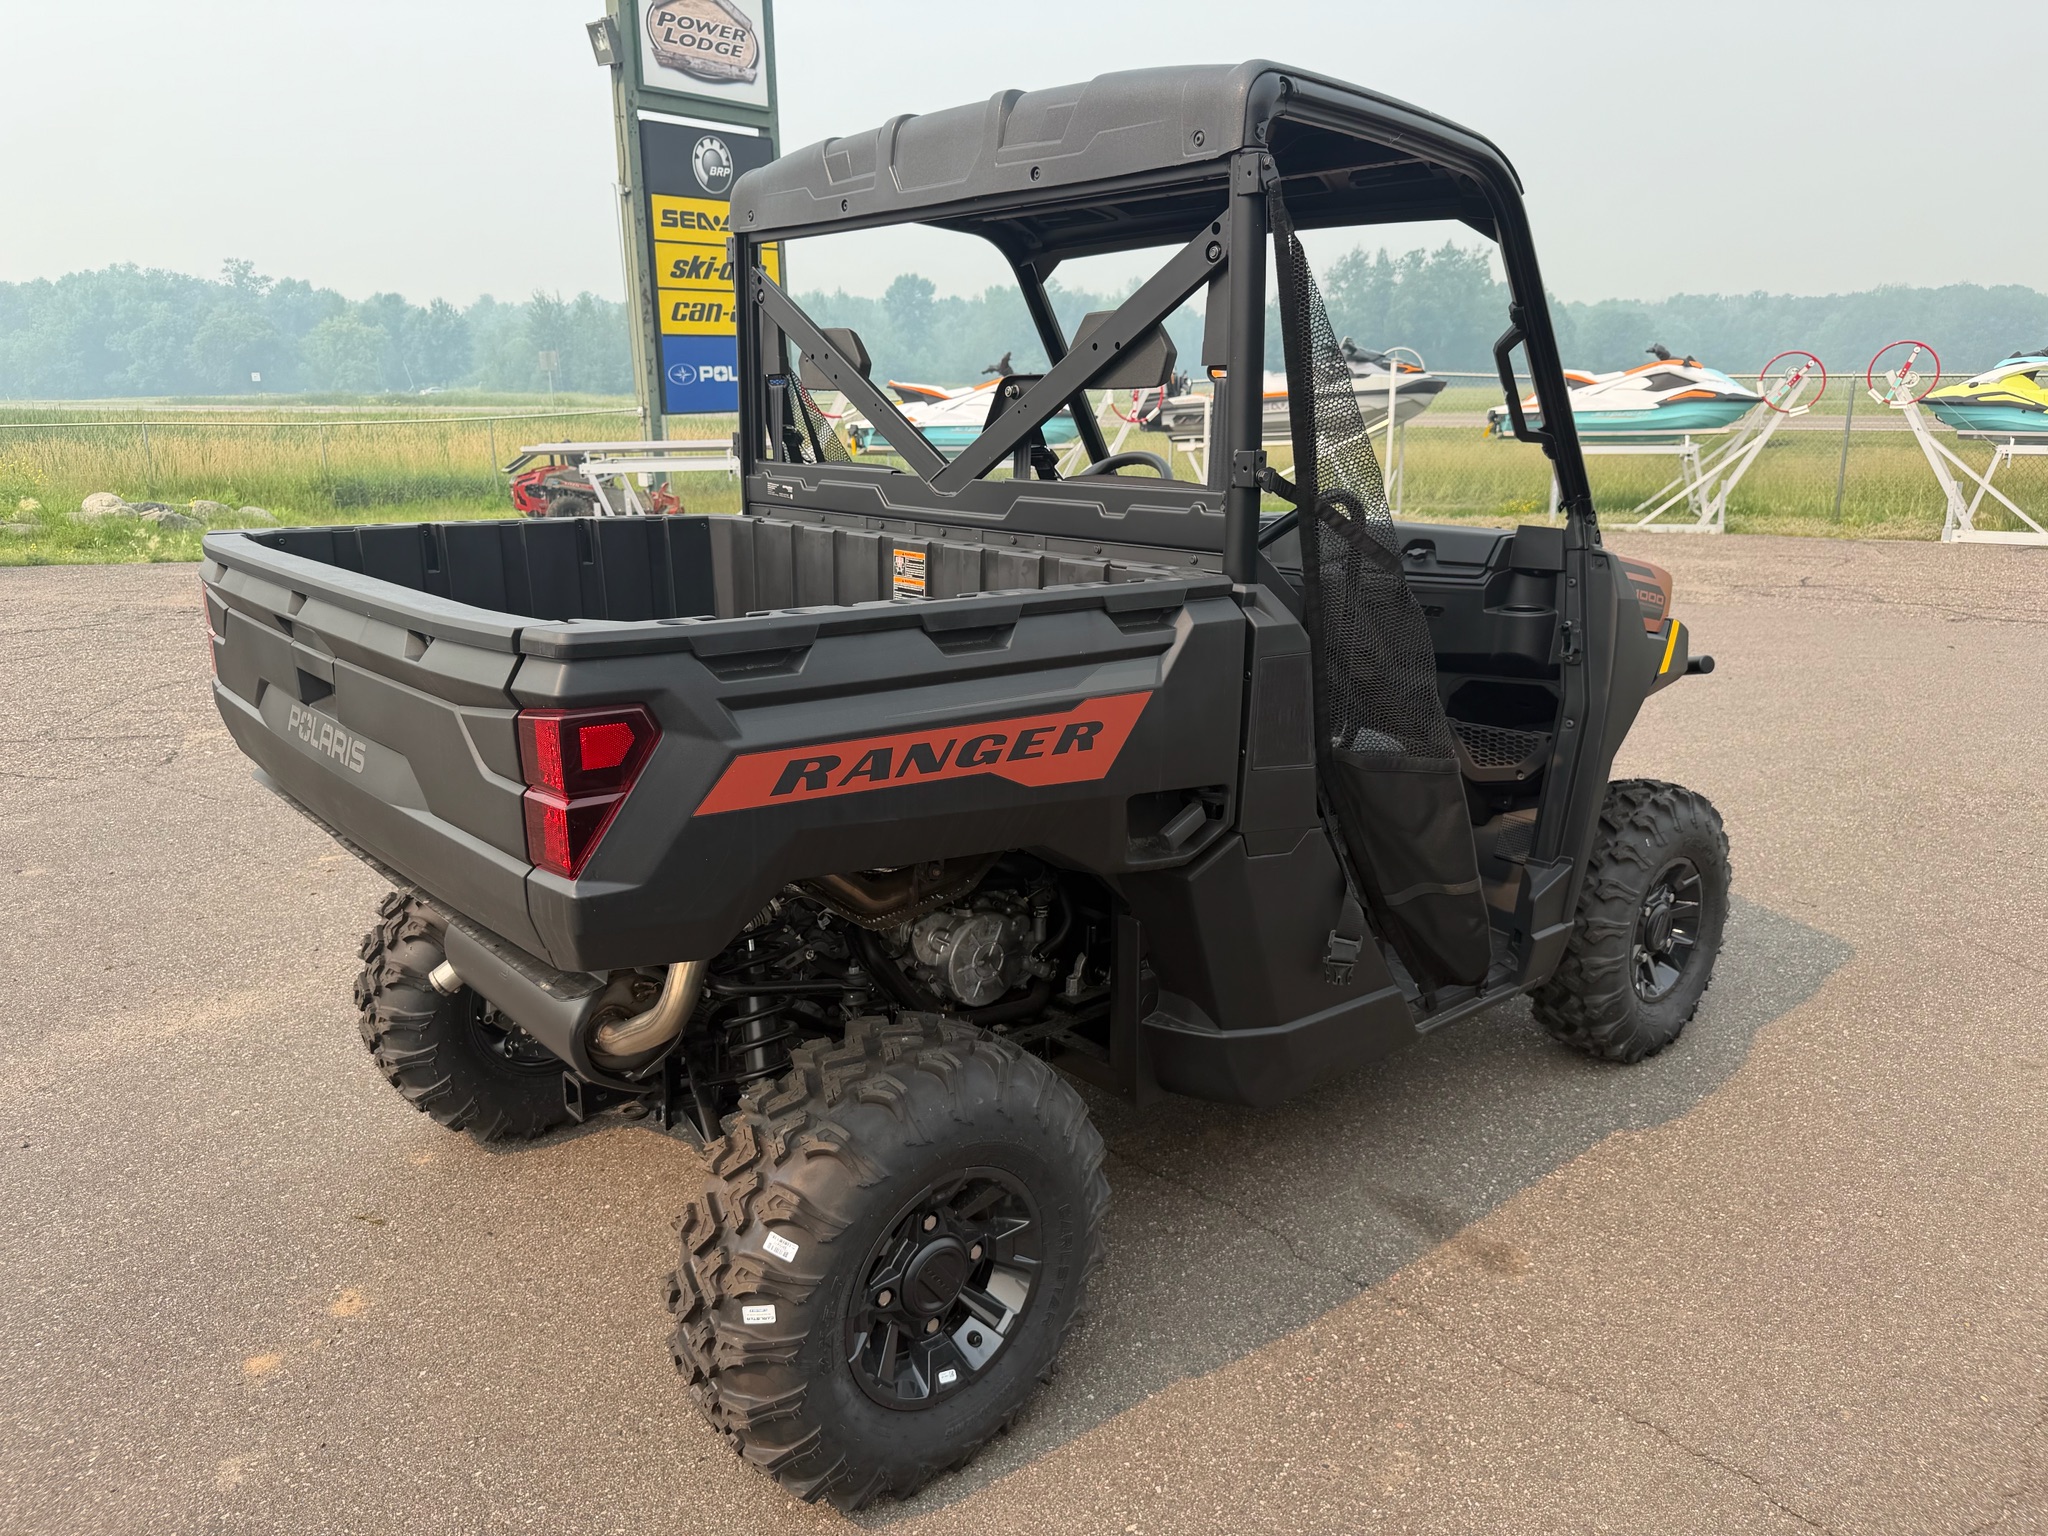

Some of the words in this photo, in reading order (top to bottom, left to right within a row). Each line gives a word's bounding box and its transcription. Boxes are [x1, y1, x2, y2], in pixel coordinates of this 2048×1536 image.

[656, 11, 747, 43] POWER
[663, 26, 744, 59] LODGE
[709, 165, 731, 178] BRP
[699, 365, 738, 382] POL
[1636, 589, 1664, 605] 1000
[287, 704, 367, 774] POLARIS
[769, 720, 1104, 797] RANGER
